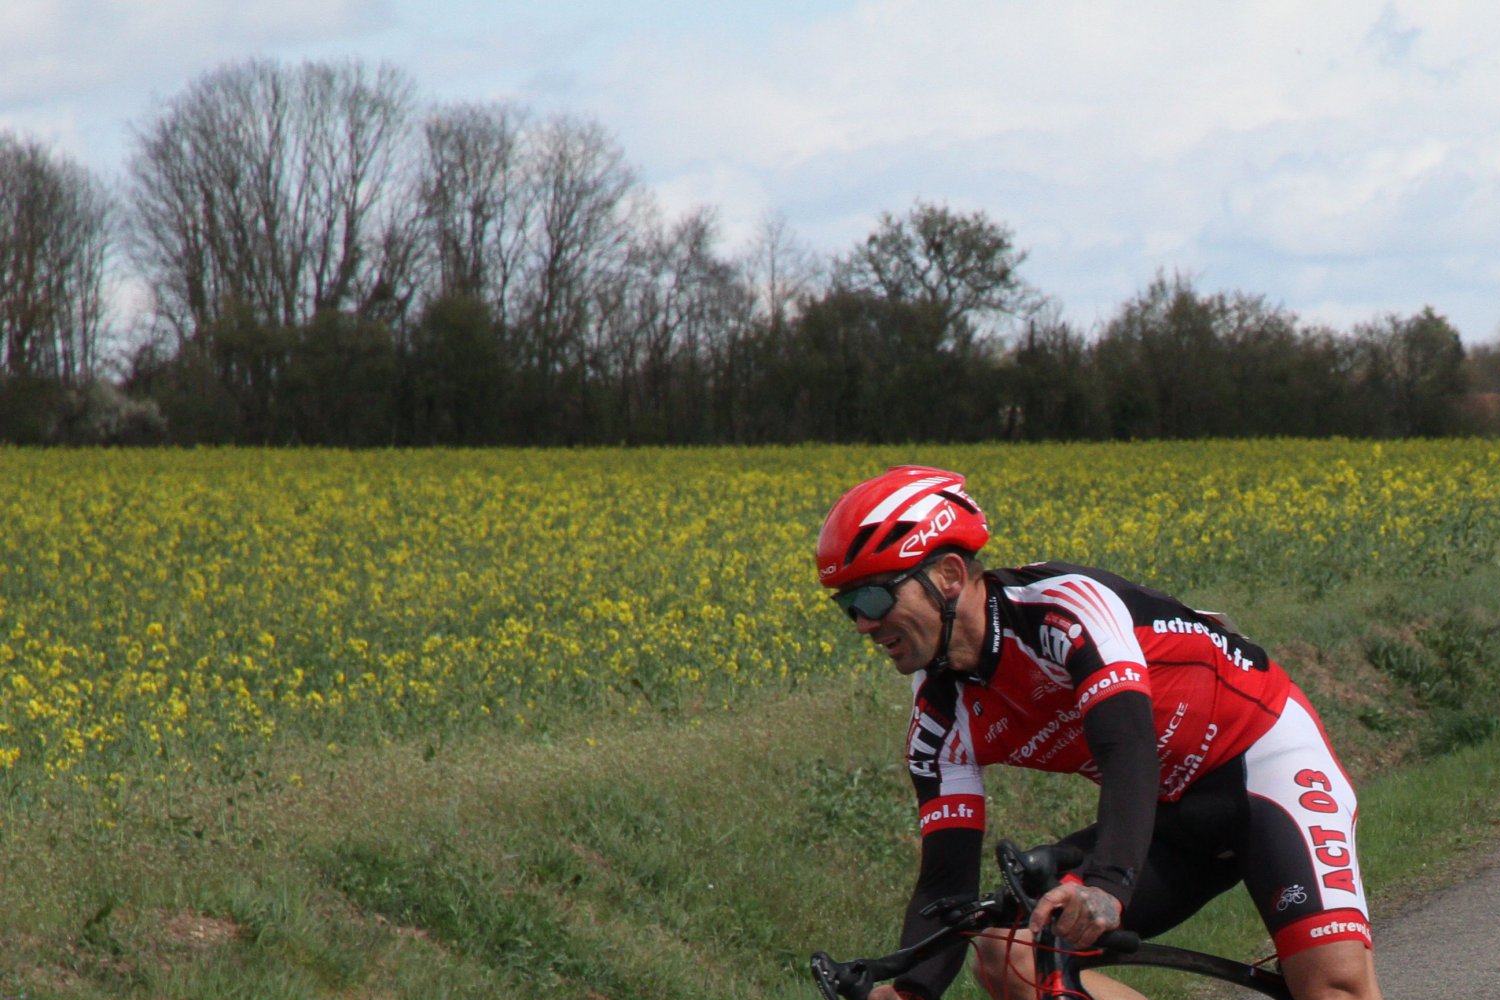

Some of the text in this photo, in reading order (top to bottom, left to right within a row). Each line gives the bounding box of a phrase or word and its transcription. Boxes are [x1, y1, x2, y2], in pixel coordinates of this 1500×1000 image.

[1152, 617, 1254, 672] actrevol.fr
[1293, 769, 1357, 895] ACT 03
